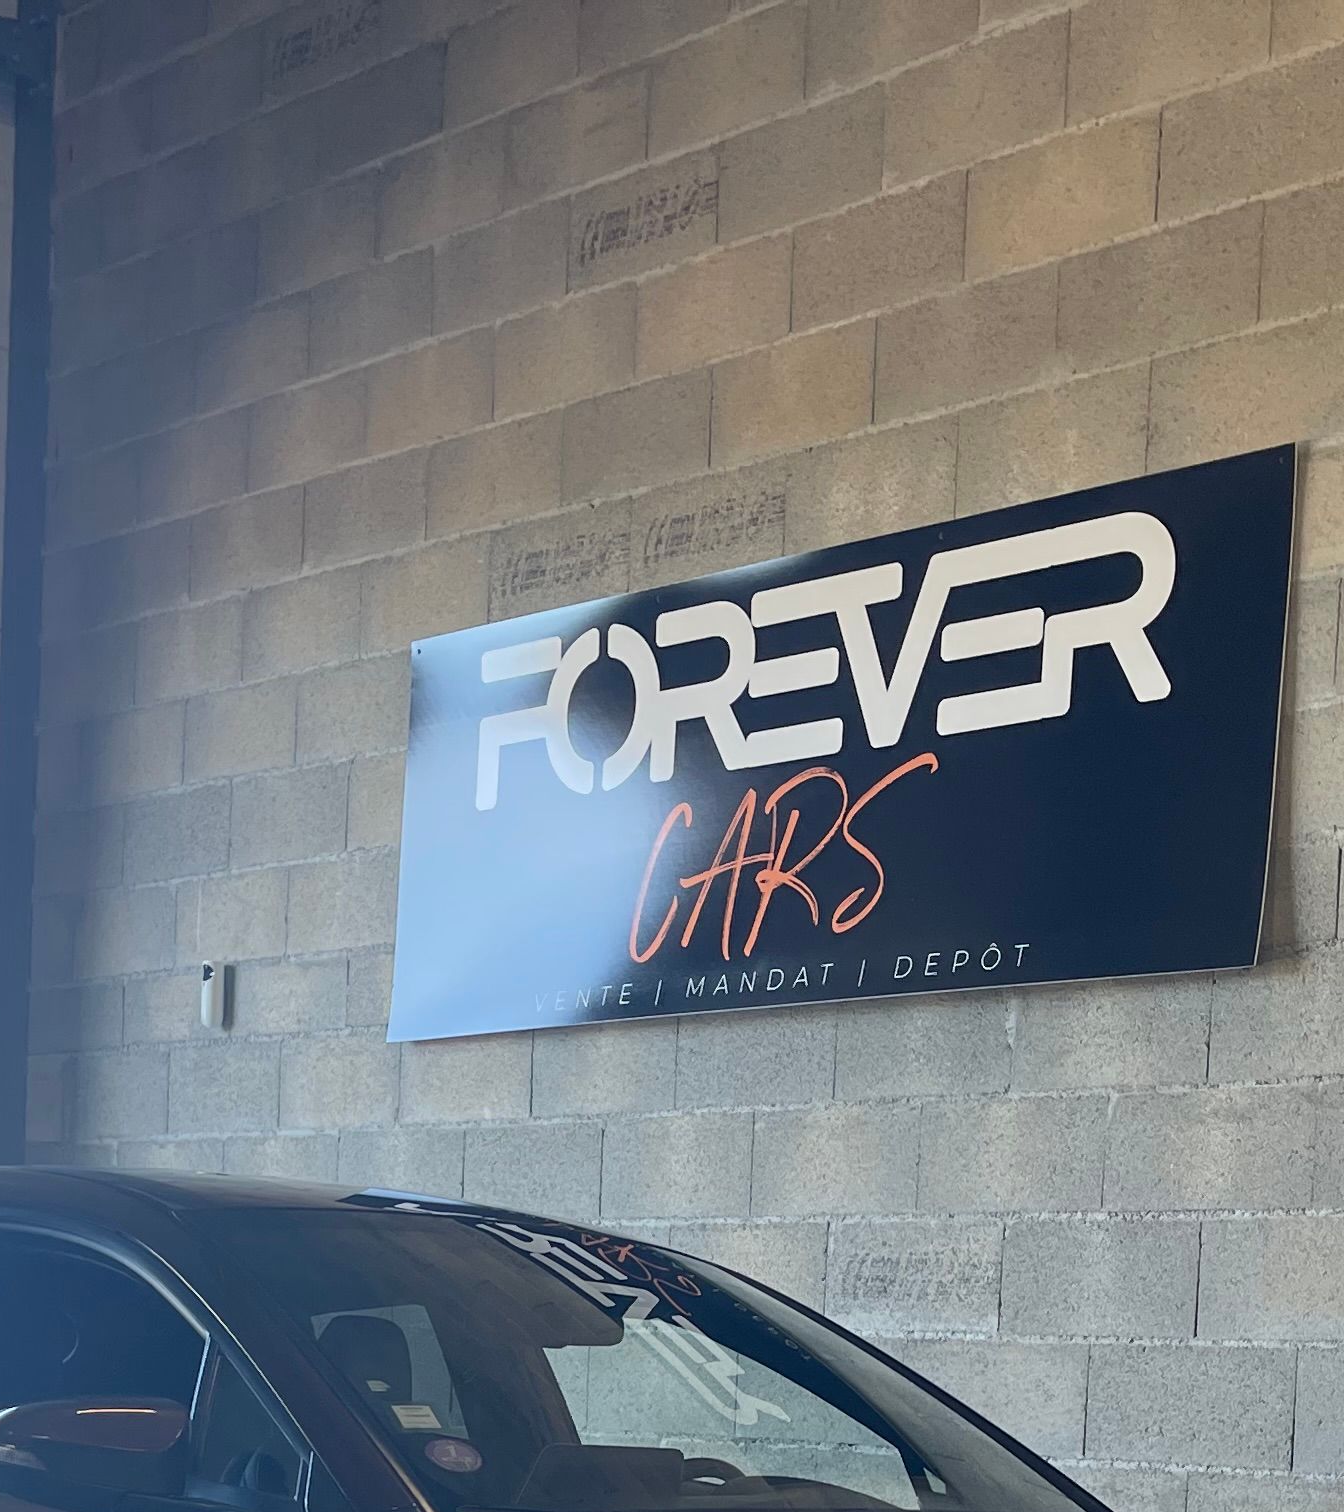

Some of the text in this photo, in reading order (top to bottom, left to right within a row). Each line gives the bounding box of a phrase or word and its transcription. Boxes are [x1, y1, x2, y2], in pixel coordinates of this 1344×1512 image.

[476, 510, 1176, 811] FOREVER
[628, 752, 940, 963] CARS
[533, 983, 635, 1013] VENTE
[684, 962, 835, 998] MANDAT
[892, 942, 1031, 981] DEPÔT
